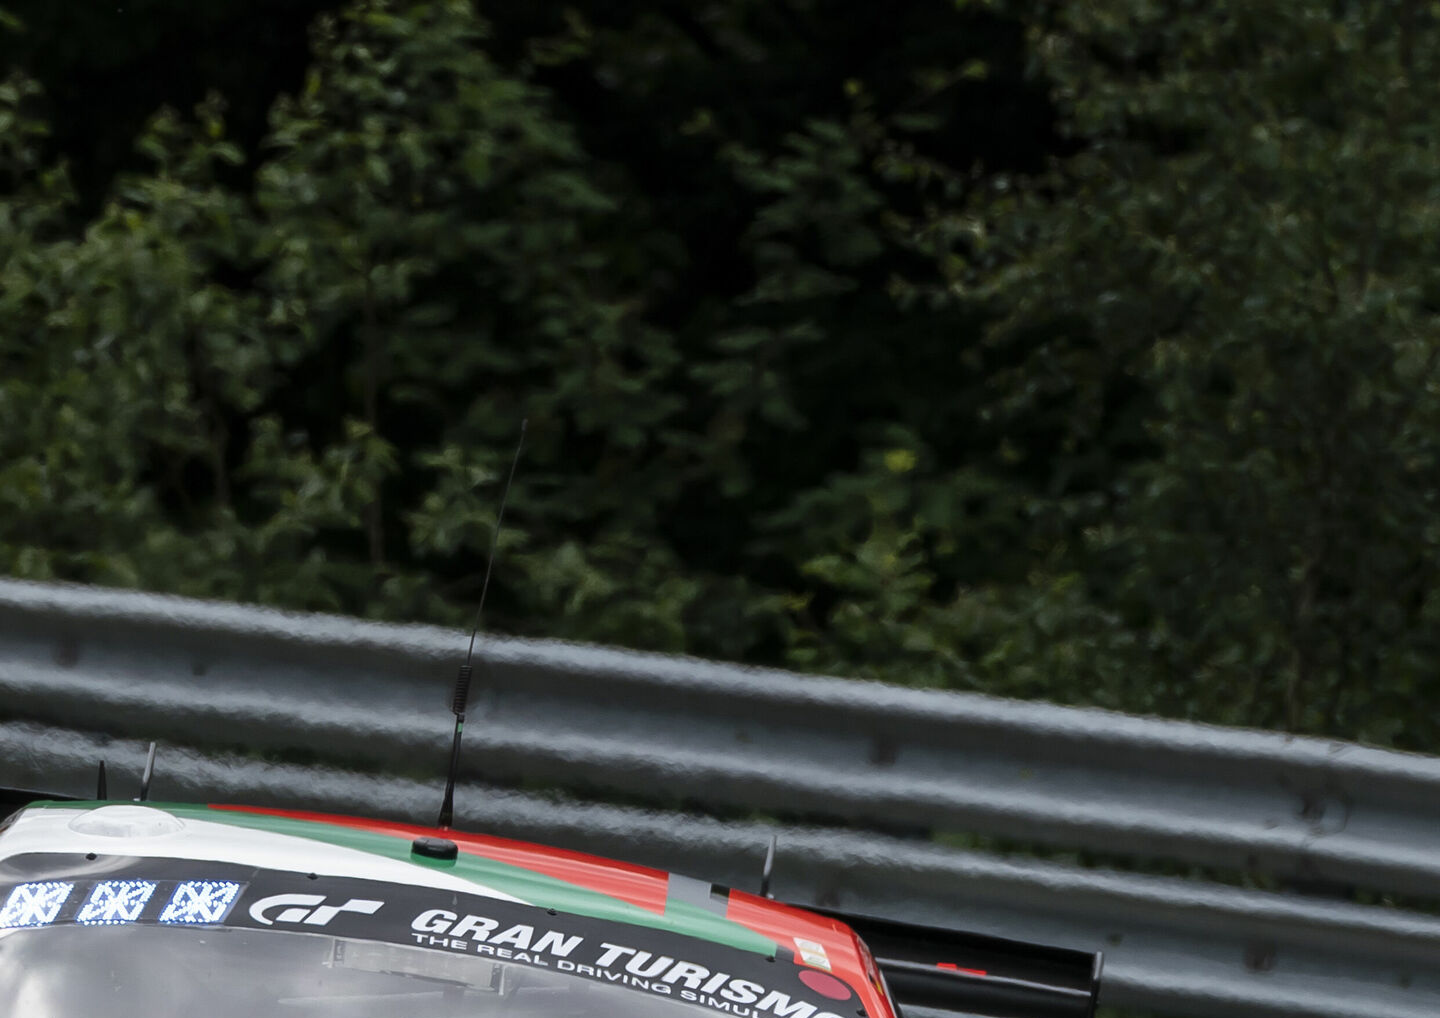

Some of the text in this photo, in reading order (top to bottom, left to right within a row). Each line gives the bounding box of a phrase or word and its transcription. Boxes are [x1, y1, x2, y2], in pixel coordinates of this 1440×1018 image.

[411, 908, 584, 958] GRAN
[411, 932, 468, 951] THE
[477, 943, 549, 967] REAL
[556, 959, 672, 996] DRIVING
